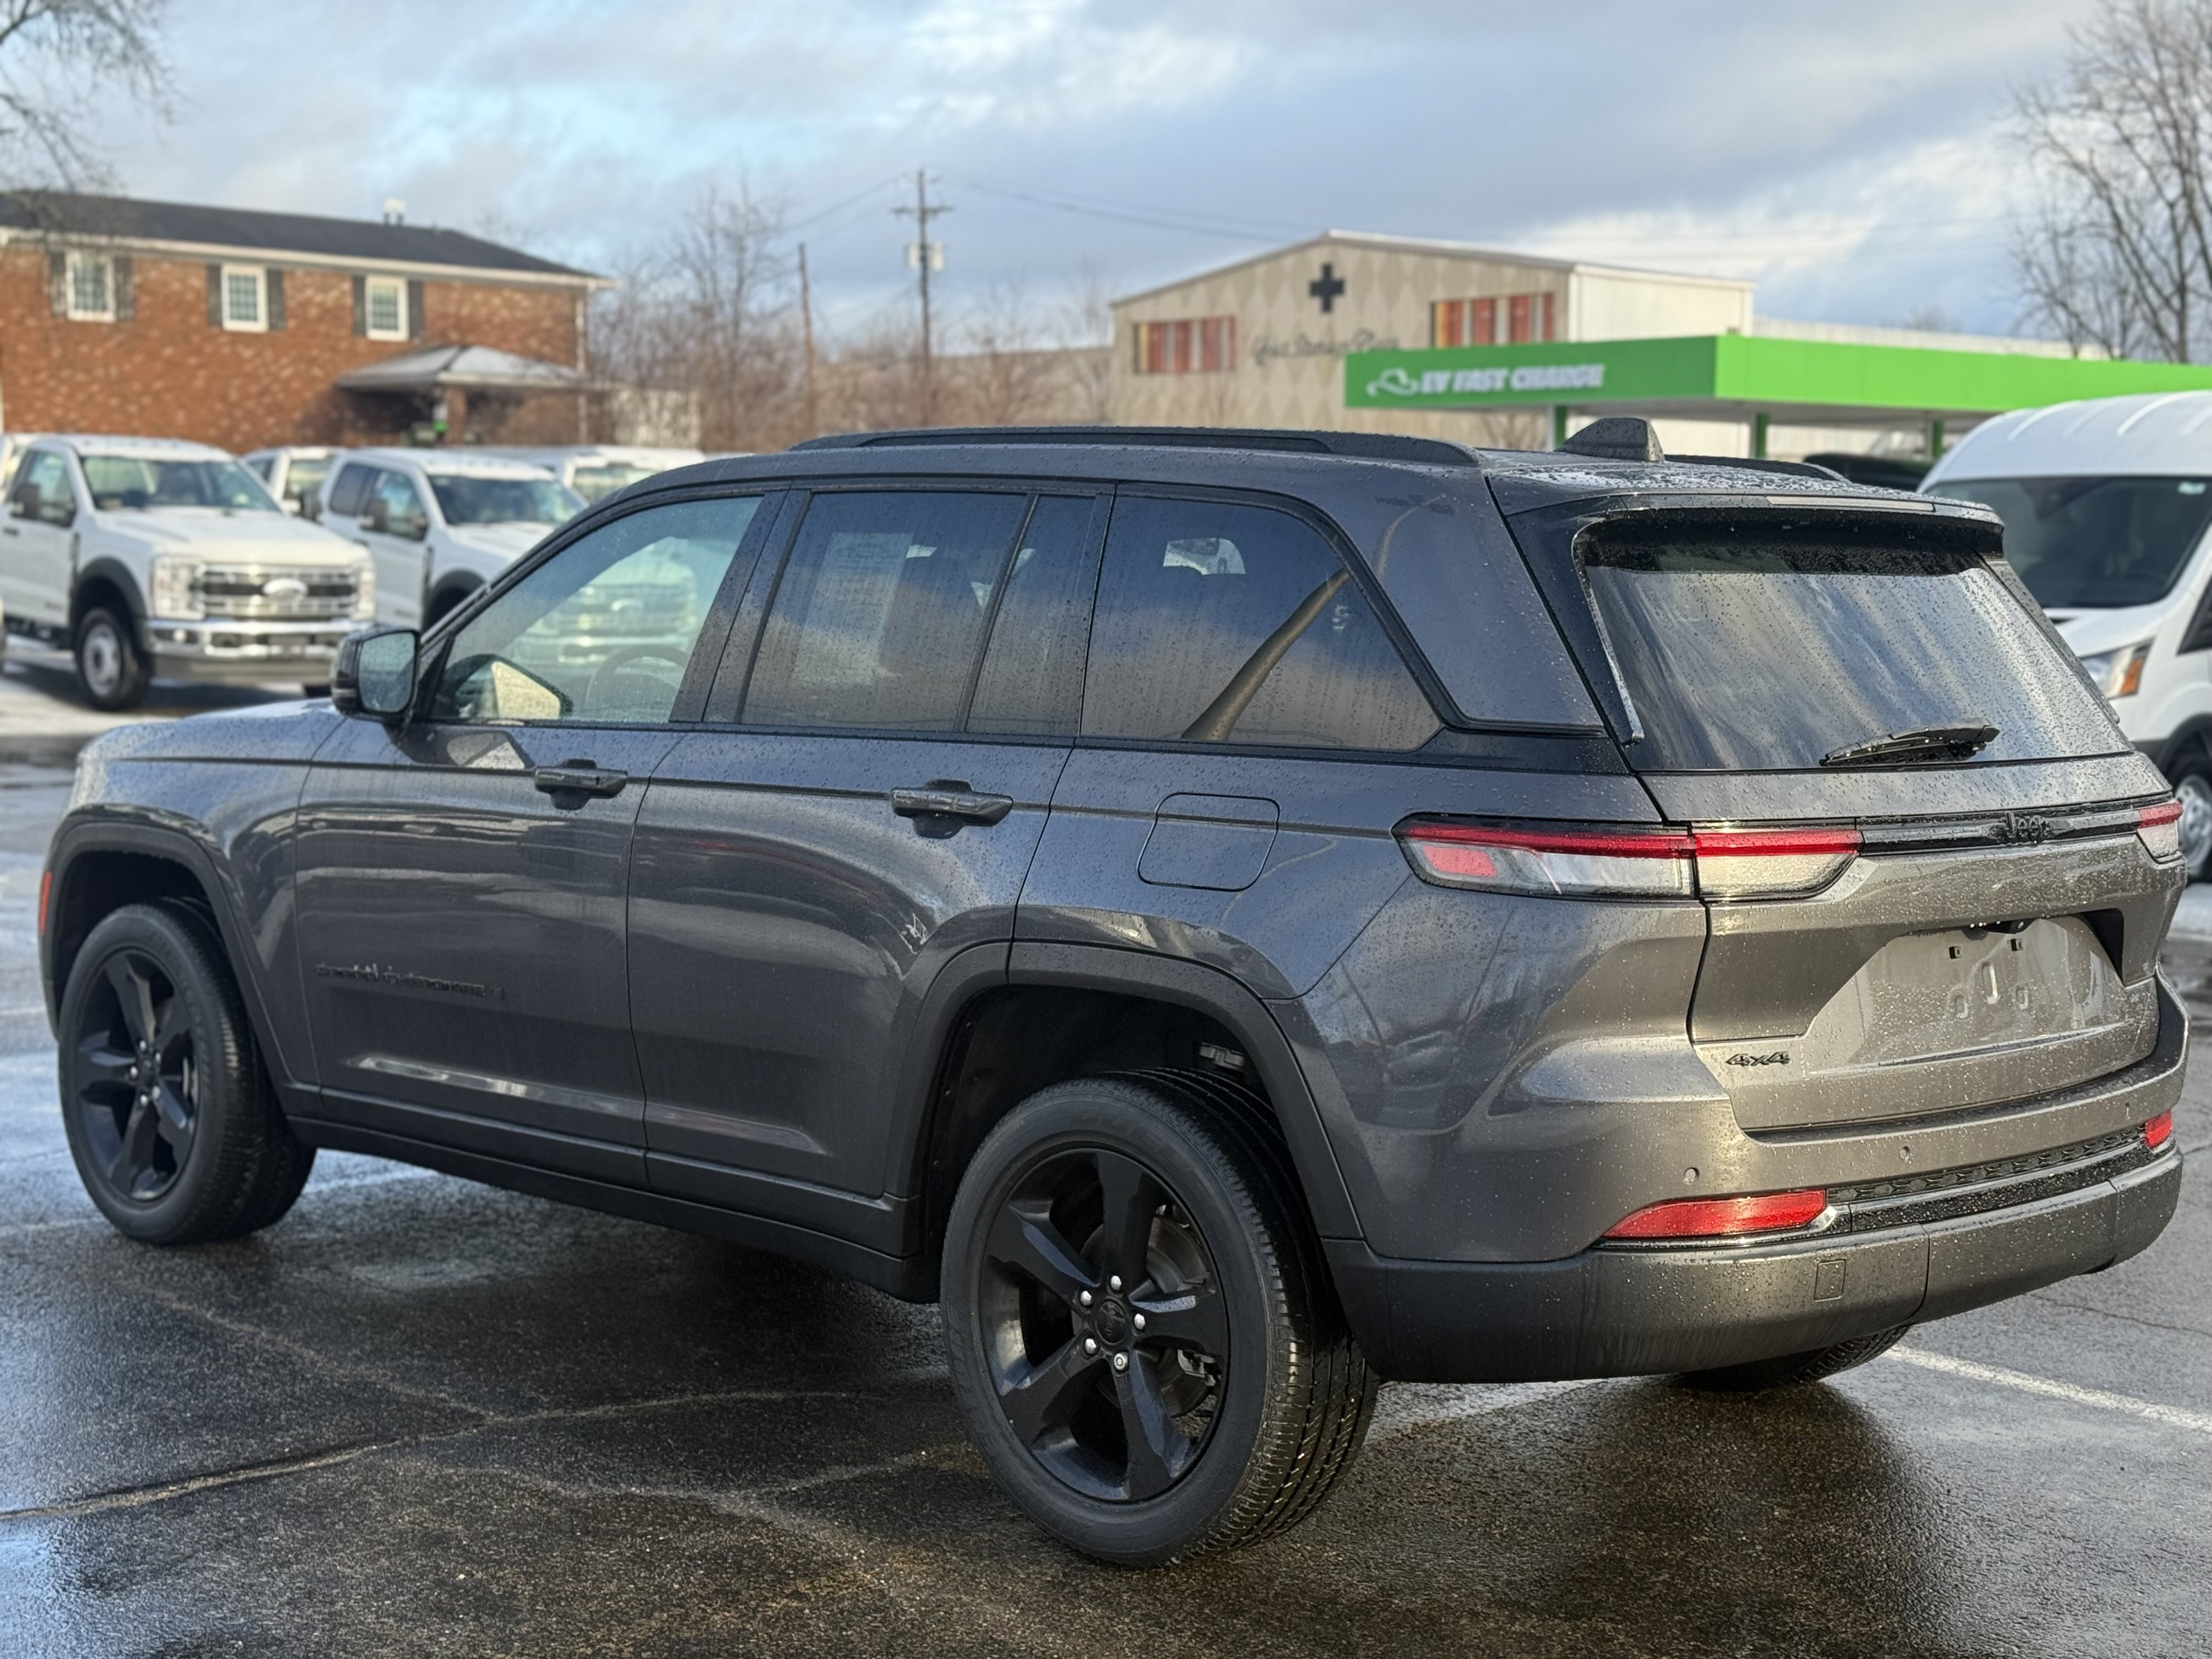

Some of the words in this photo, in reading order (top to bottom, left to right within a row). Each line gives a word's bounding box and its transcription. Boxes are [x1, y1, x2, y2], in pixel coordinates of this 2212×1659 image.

[1420, 369, 1451, 394] EV
[1453, 368, 1508, 392] FAST
[1511, 363, 1605, 391] CHARGE
[1726, 1051, 1791, 1067] 4x4
